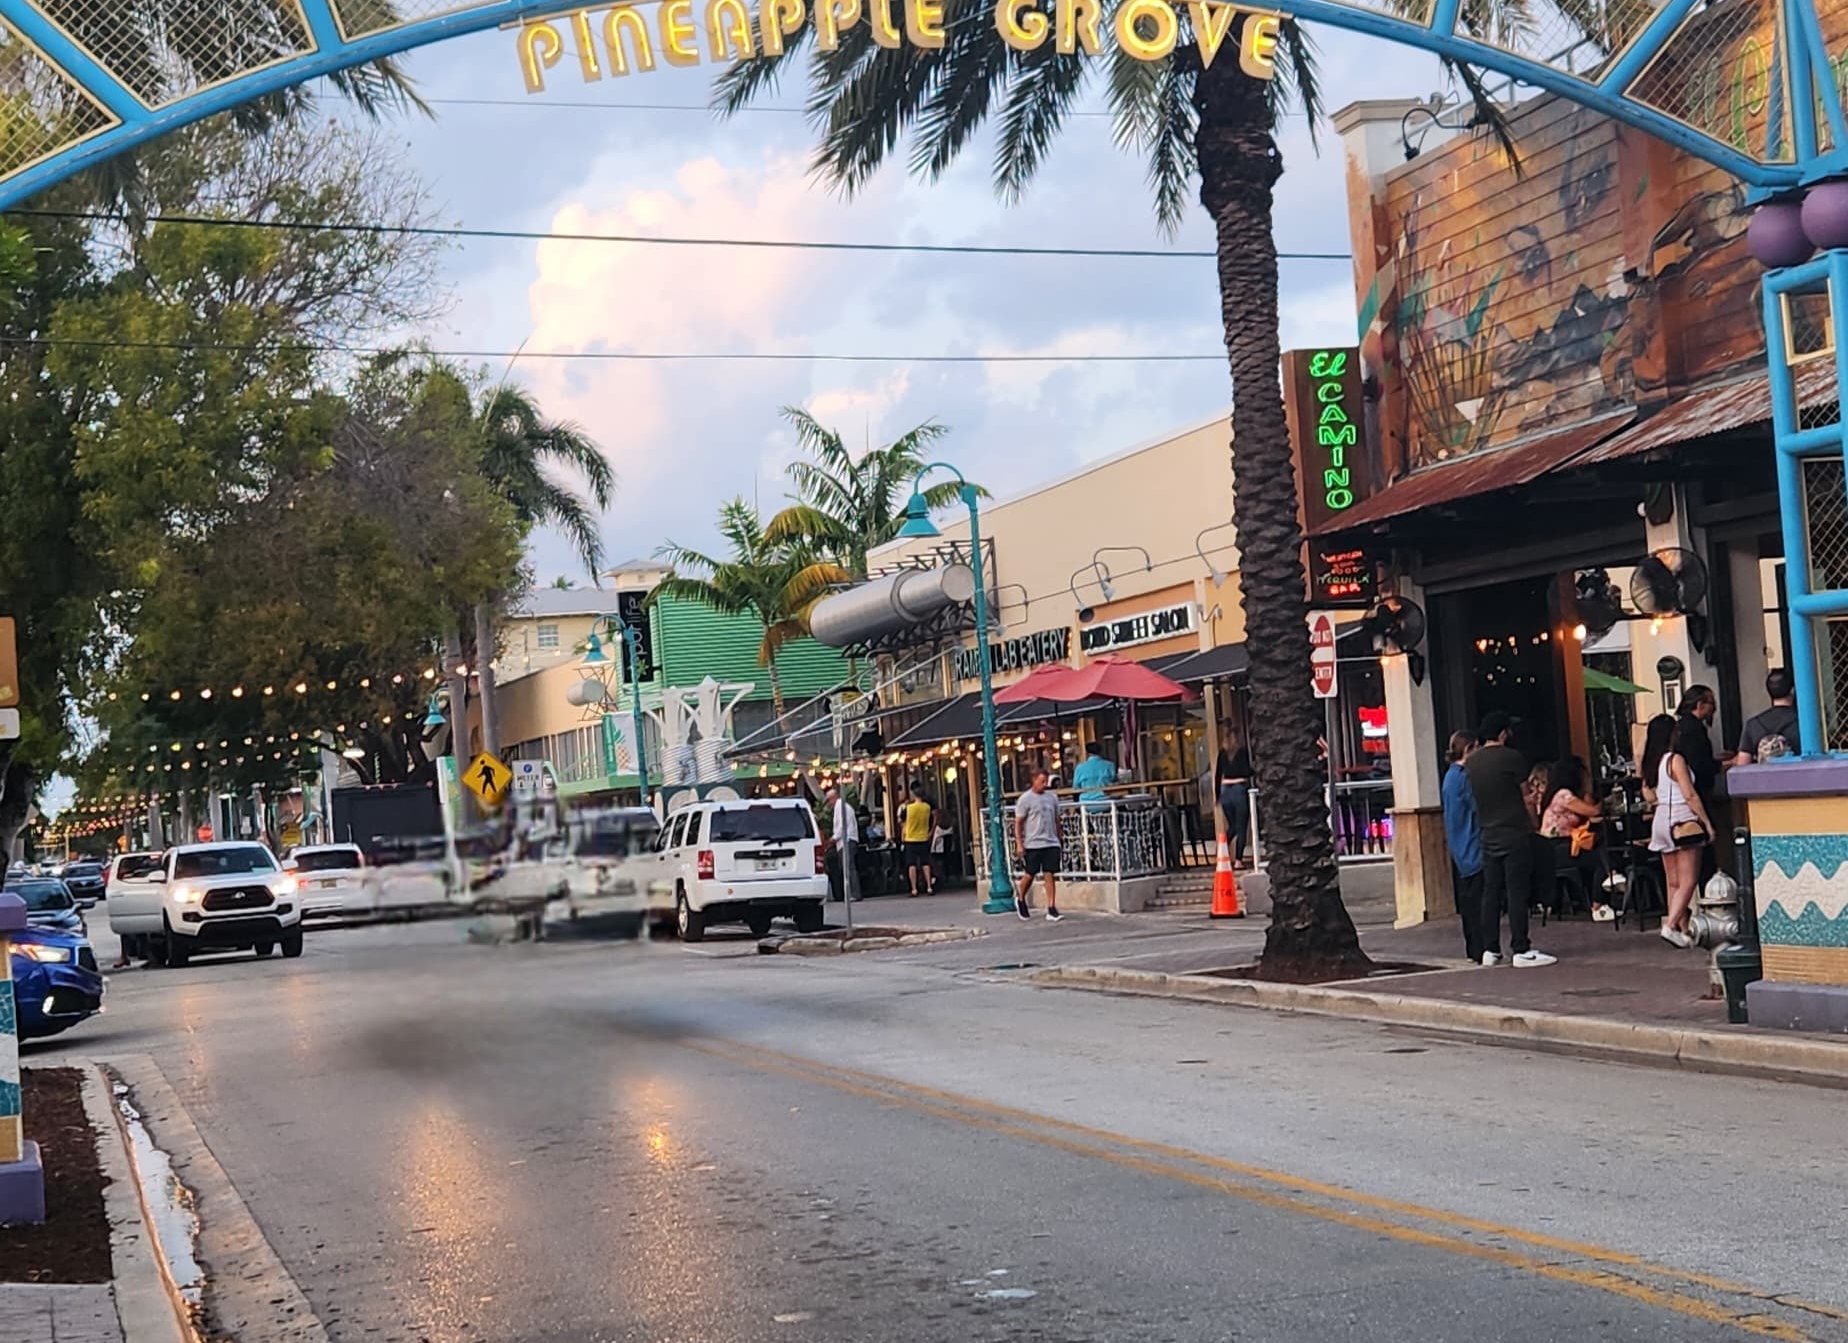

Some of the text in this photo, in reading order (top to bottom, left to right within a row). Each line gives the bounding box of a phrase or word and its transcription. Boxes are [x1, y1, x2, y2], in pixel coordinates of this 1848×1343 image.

[1309, 352, 1347, 377] El
[1317, 382, 1357, 508] CAMINO
[954, 627, 1067, 681] RAME LAB EATERY
